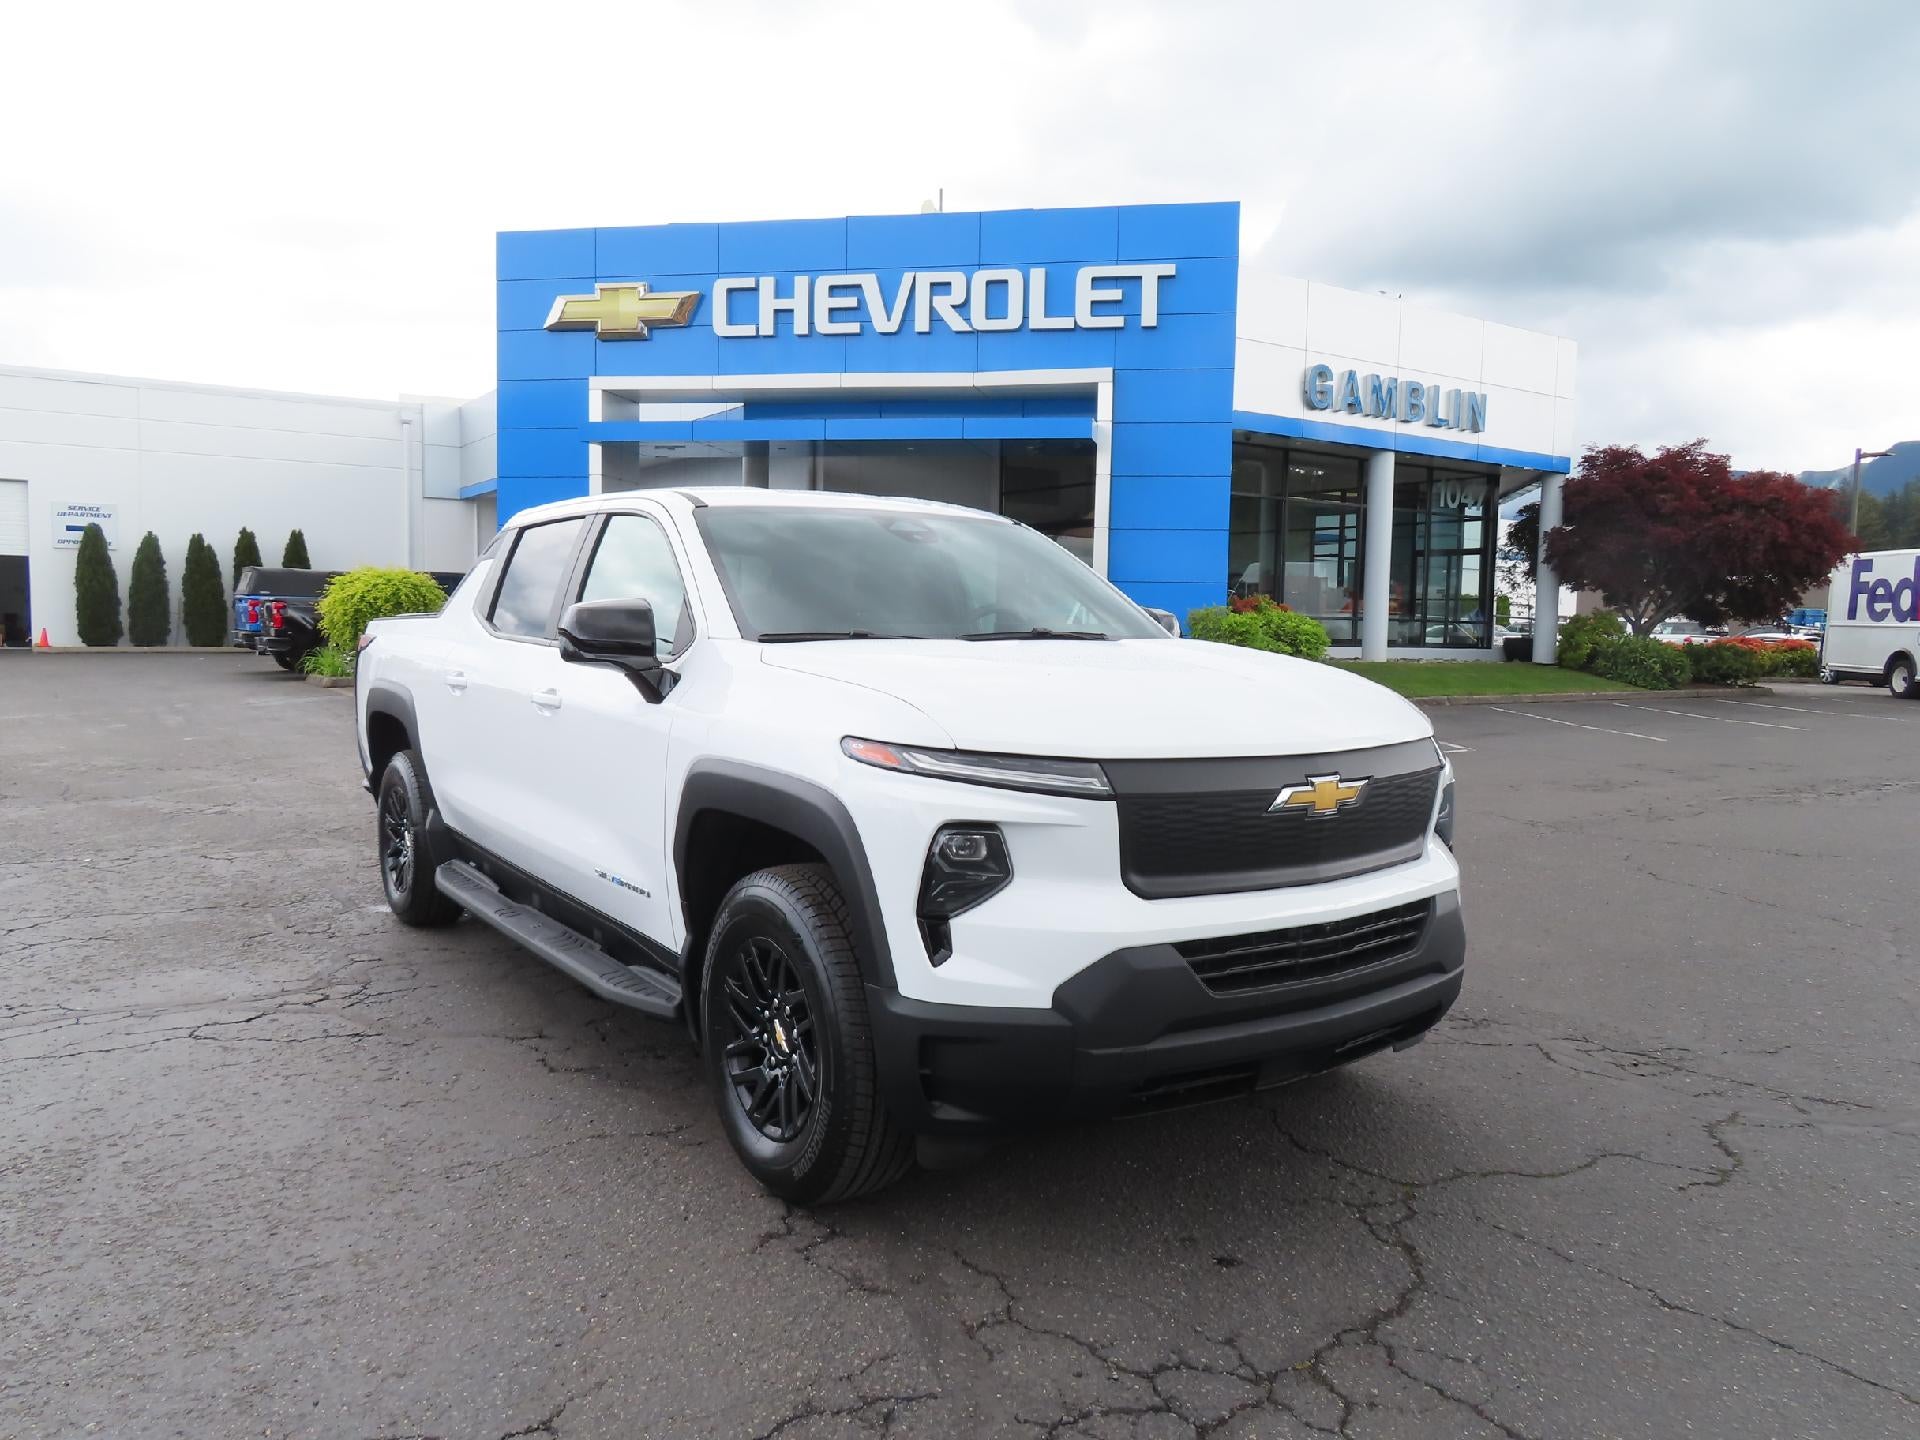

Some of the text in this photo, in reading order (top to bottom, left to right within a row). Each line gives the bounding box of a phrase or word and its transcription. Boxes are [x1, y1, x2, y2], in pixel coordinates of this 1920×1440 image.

[712, 263, 1177, 337] CHEVROLET
[1304, 364, 1487, 433] GAMBLIN
[56, 511, 113, 519] DEPARTMENT
[1440, 479, 1487, 511] 1047
[1847, 556, 1920, 623] Fed
